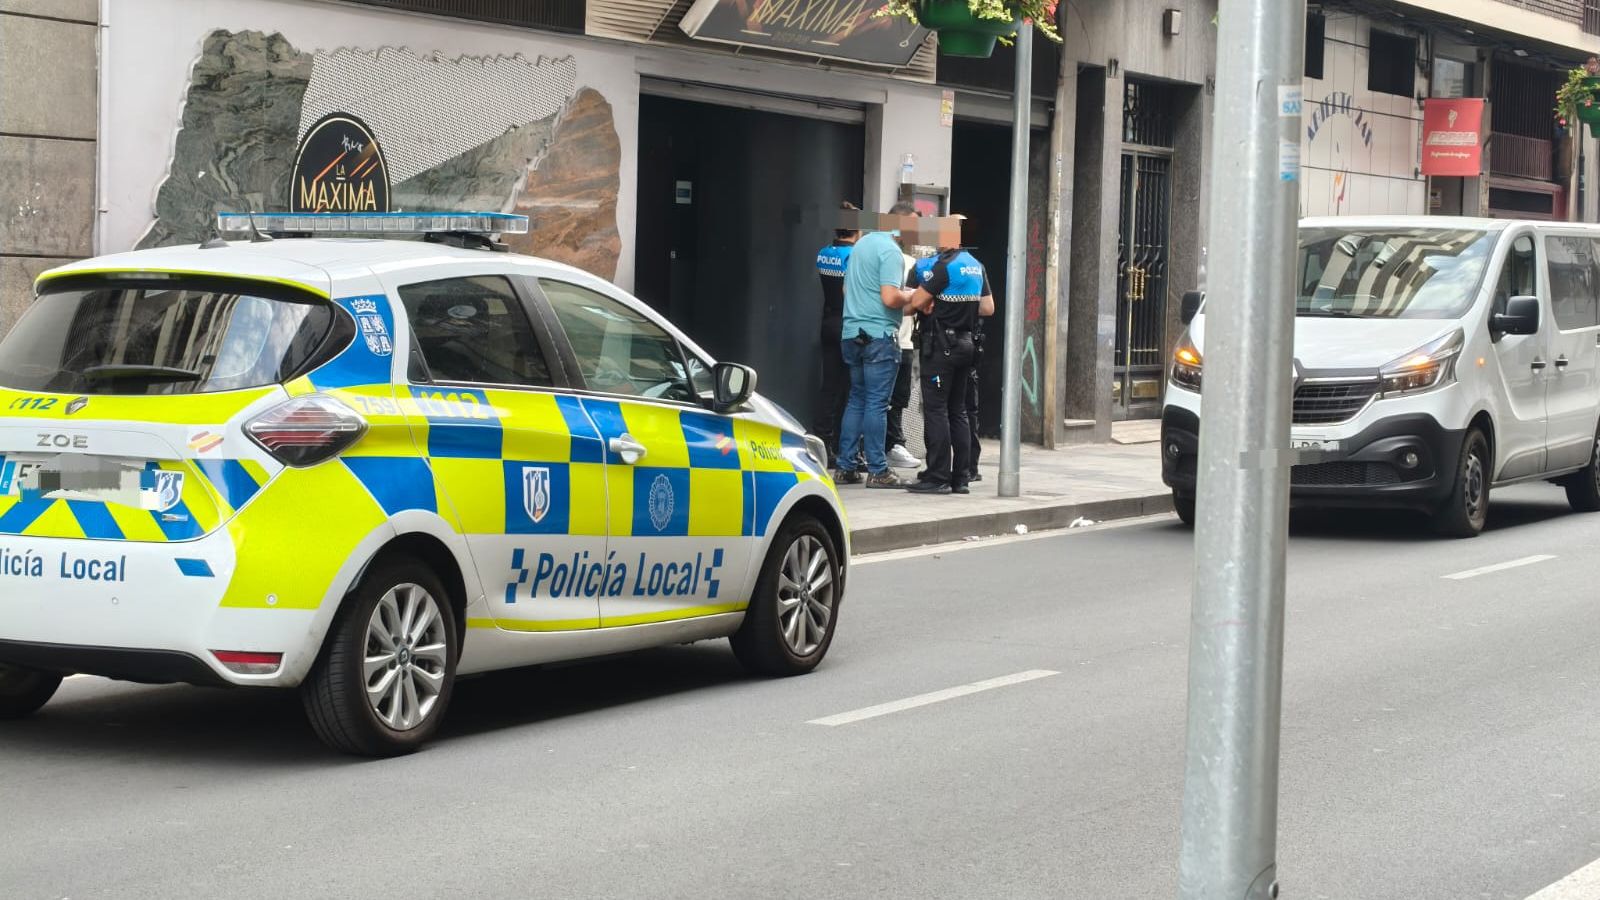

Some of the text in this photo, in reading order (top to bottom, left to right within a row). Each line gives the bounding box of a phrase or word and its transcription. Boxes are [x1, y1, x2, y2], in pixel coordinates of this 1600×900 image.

[336, 164, 345, 176] LA
[301, 175, 377, 211] MAXIMA
[355, 396, 397, 415] 759
[36, 433, 89, 449] ZOE
[61, 552, 126, 582] Local
[531, 550, 703, 599] Policía Local
